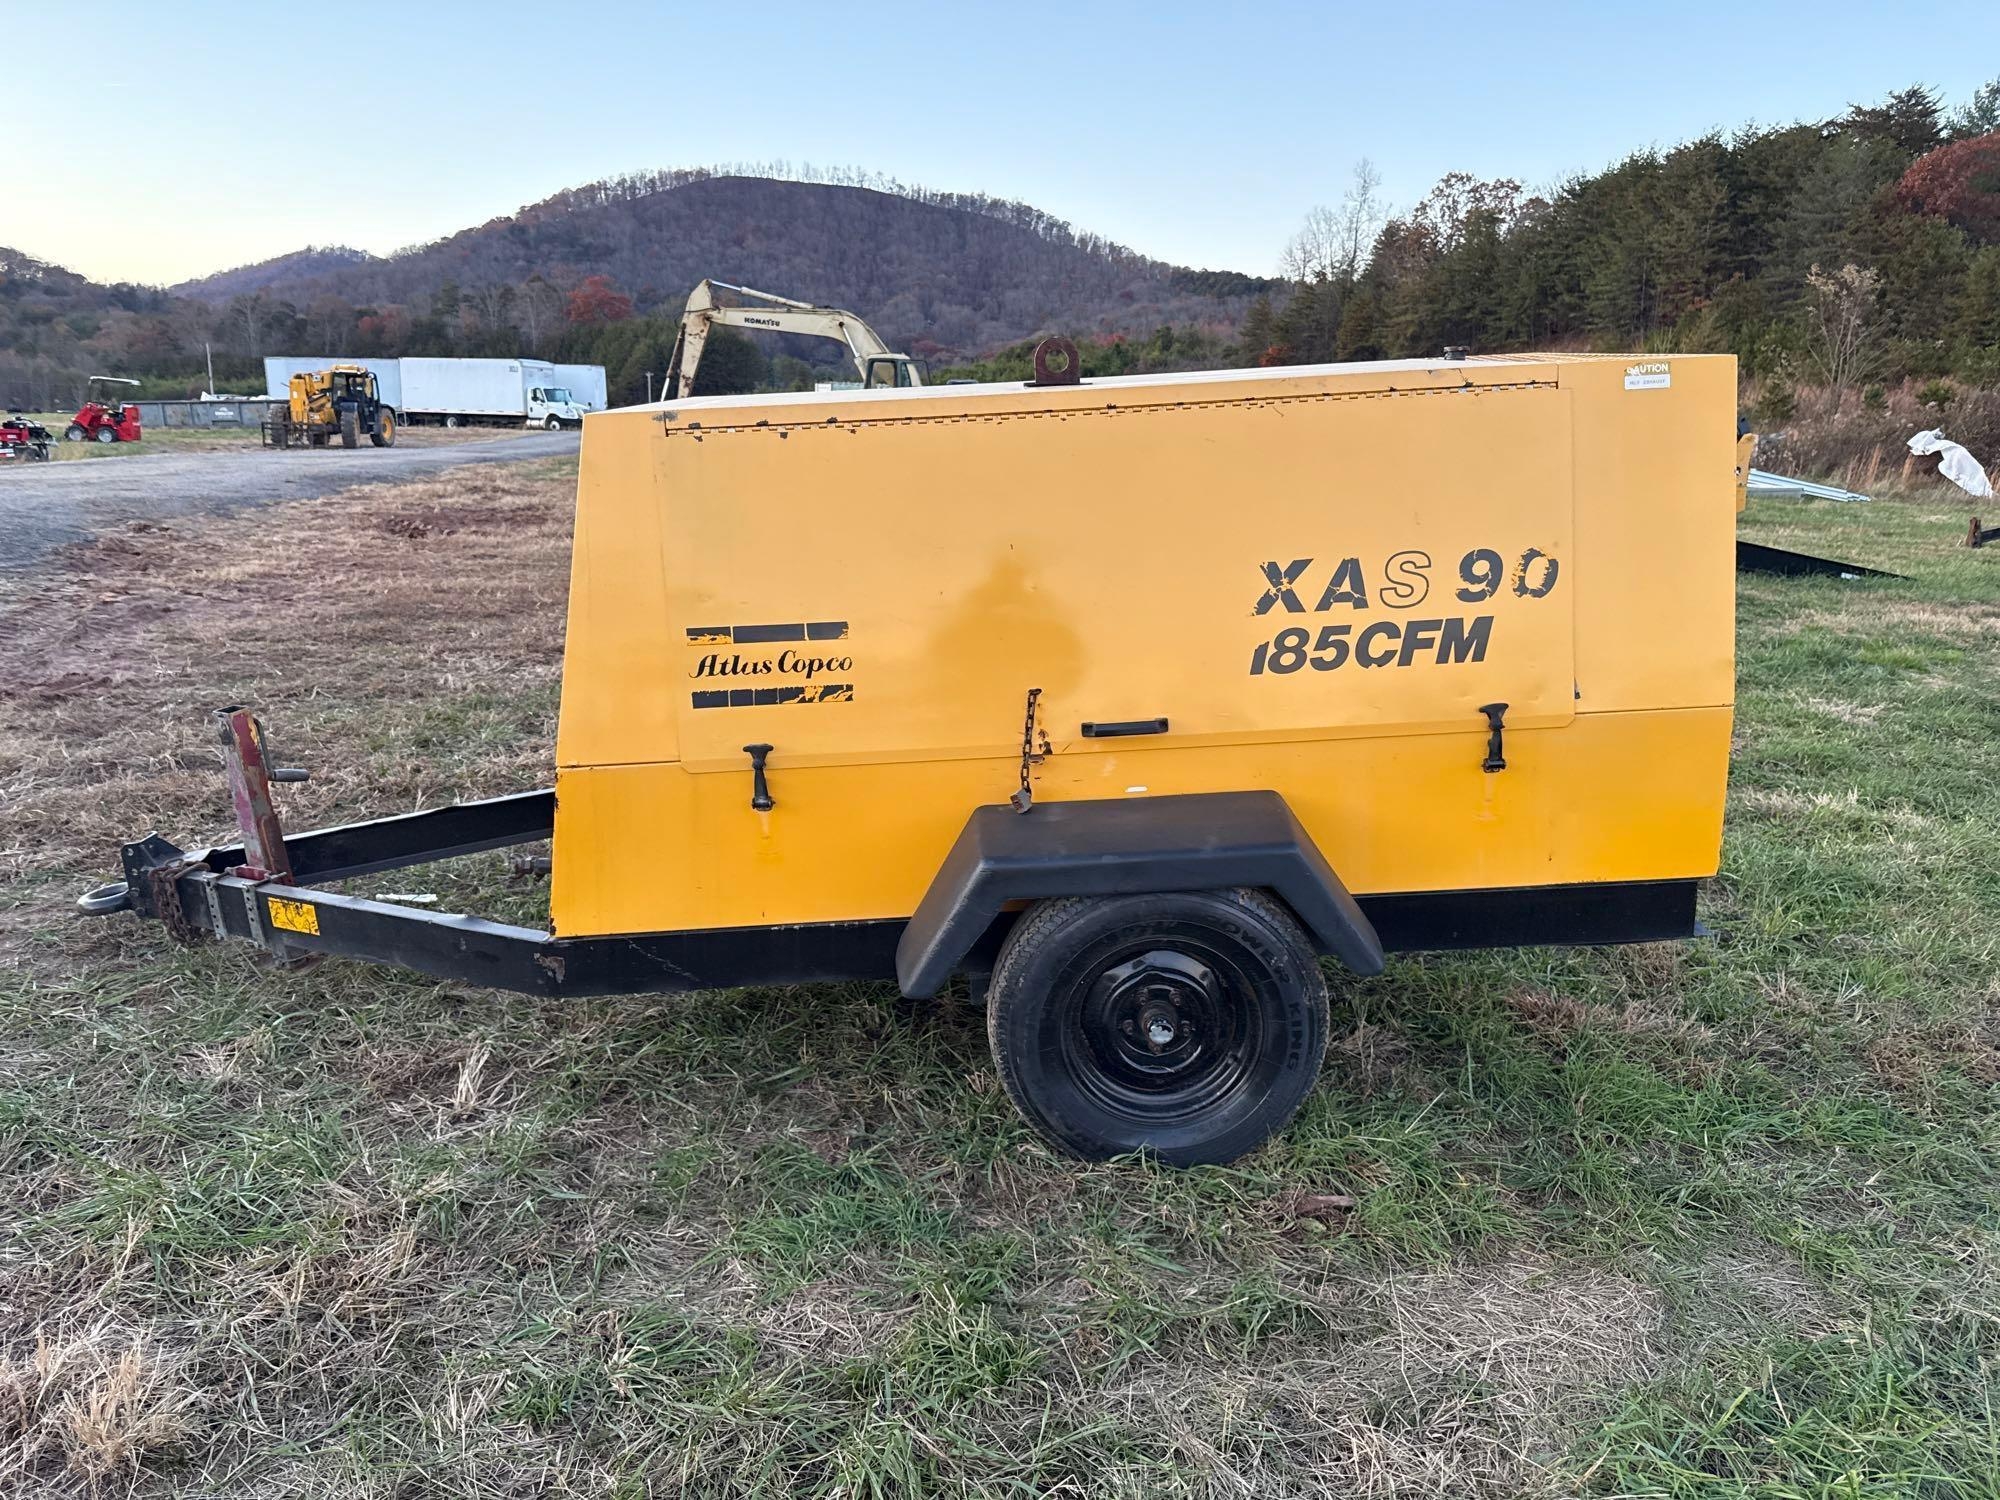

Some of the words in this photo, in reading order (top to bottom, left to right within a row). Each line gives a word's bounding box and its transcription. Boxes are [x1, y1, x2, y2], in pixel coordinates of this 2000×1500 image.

[744, 317, 781, 327] KOMATSU
[1626, 363, 1669, 375] CAUTION
[1249, 550, 1432, 617] XAS
[1454, 547, 1560, 603] 90
[688, 653, 773, 679] Atlas
[777, 649, 853, 679] Copco
[1249, 615, 1495, 676] 185CFM
[1287, 1001, 1304, 1072] KING
